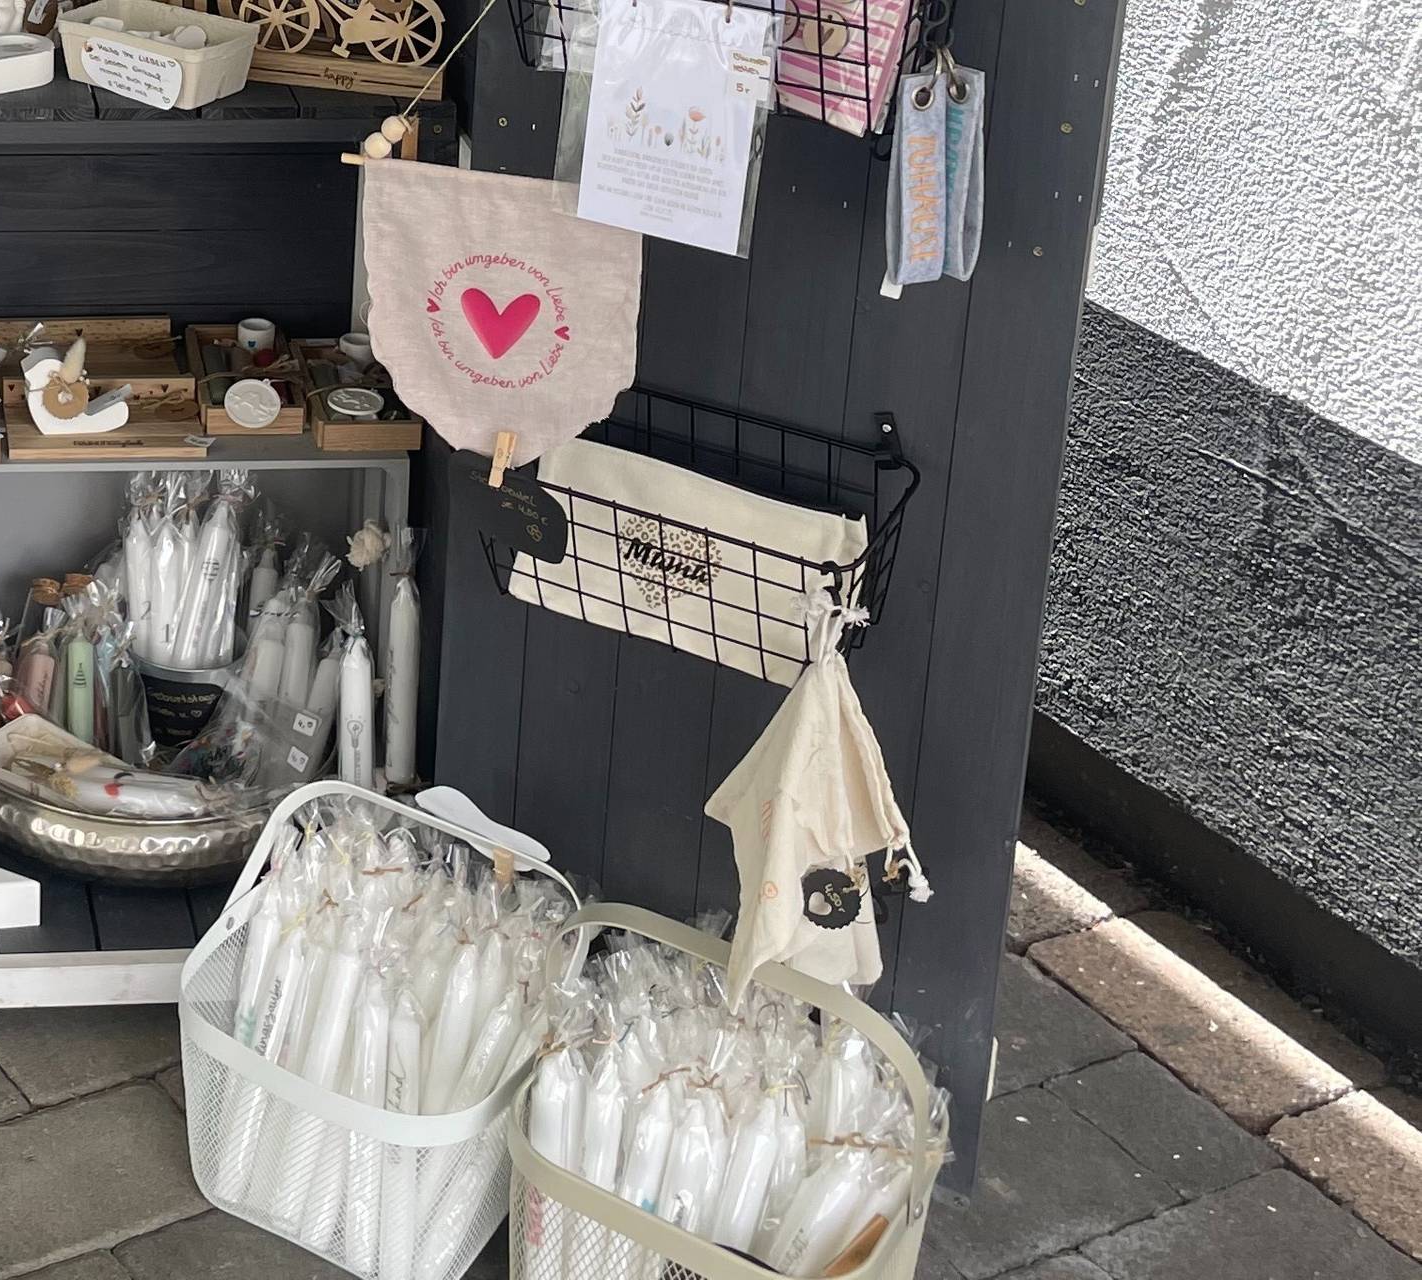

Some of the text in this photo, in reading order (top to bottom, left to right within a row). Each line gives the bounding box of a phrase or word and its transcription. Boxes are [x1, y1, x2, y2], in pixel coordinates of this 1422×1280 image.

[428, 253, 565, 322] Ich bin umgeben von Liebe
[428, 317, 564, 389] Ich bin umgeben von Liebe
[140, 600, 152, 620] 2
